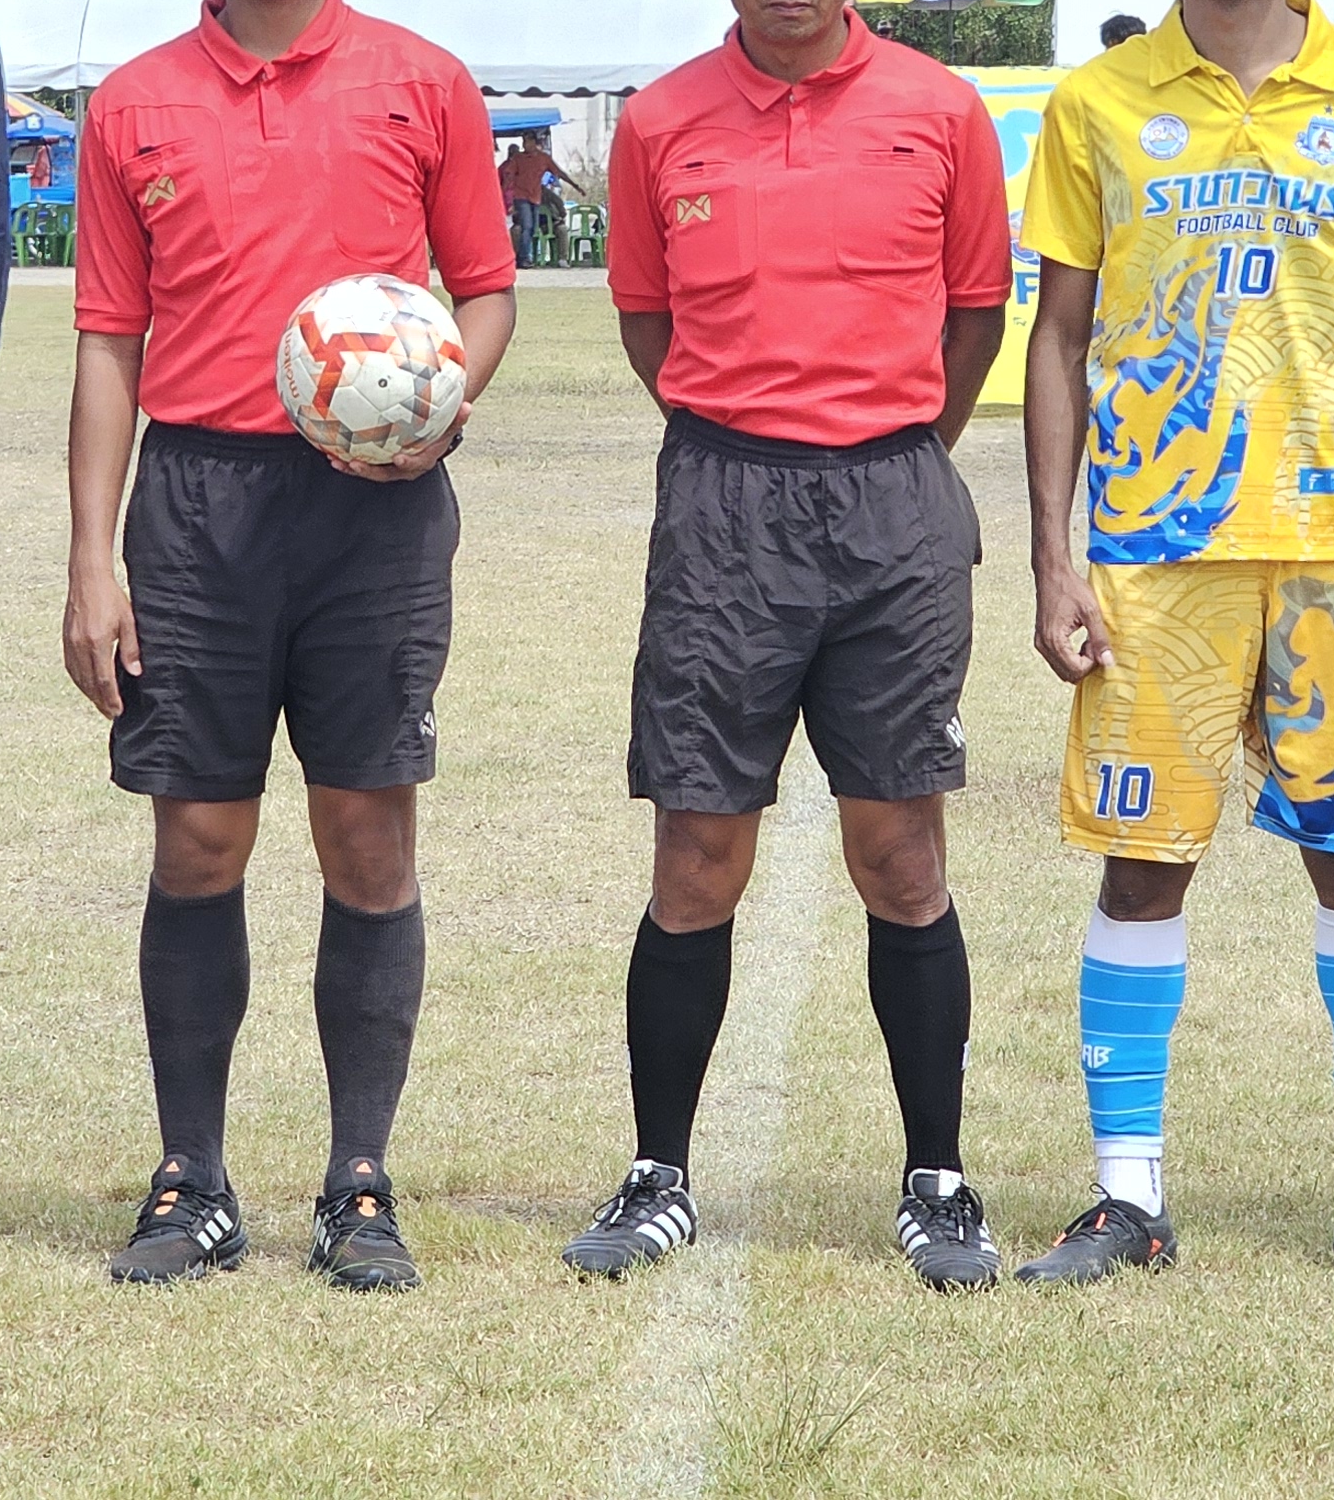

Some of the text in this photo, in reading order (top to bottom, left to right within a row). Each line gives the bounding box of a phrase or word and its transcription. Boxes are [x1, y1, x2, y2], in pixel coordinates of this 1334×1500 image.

[1176, 213, 1320, 238] FOOTBALL CLUB
[1214, 243, 1279, 299] 10
[284, 332, 300, 398] molten
[1095, 763, 1154, 821] 10
